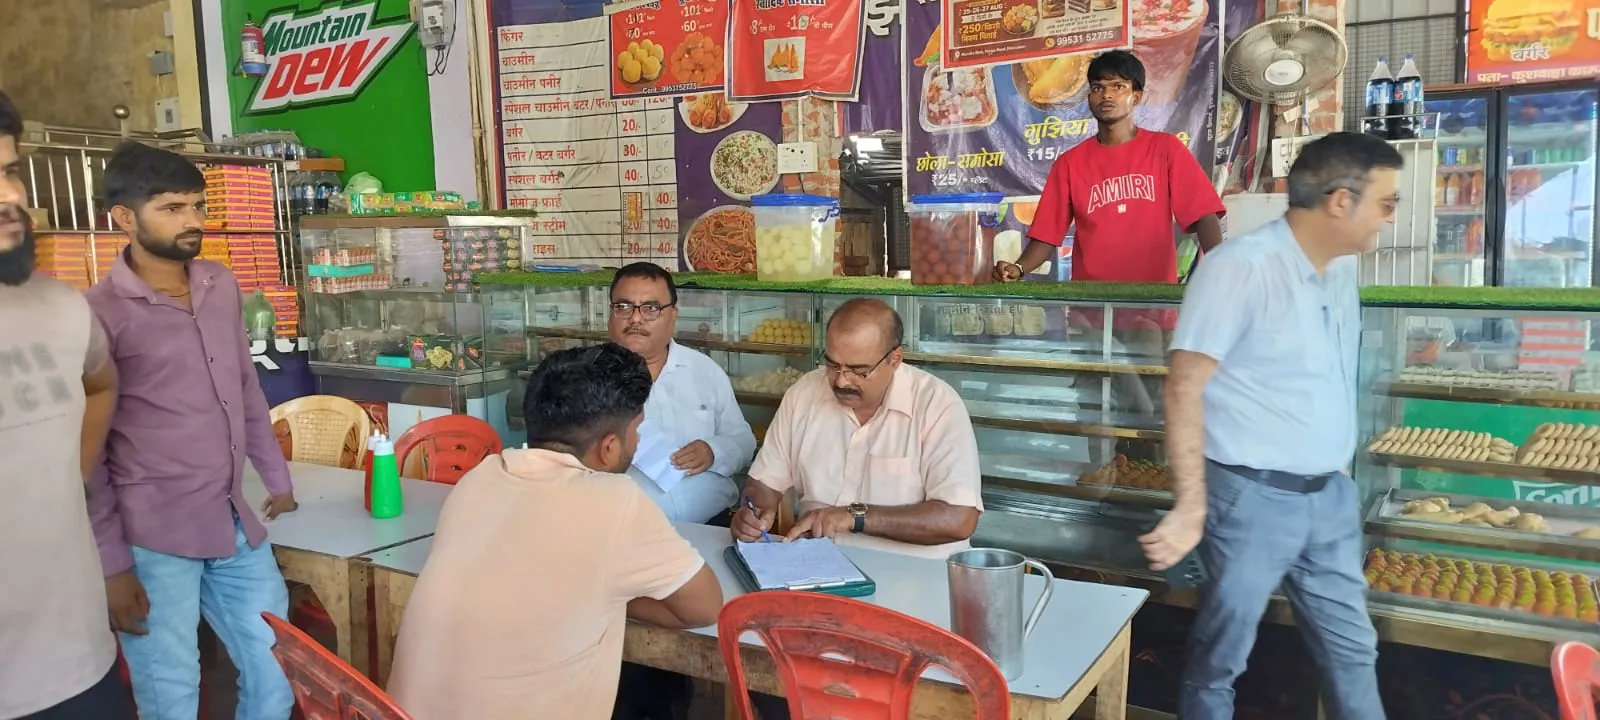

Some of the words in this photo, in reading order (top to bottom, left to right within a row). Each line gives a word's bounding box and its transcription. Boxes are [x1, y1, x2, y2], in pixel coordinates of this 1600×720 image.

[264, 13, 367, 57] Mountain
[1056, 34, 1083, 46] 99531
[1086, 30, 1114, 41] 52775
[622, 118, 641, 132] 20/-
[623, 144, 642, 156] 30/-
[624, 168, 643, 181] 40/-
[656, 192, 675, 205] 40/-
[1087, 173, 1155, 215] AMIRI
[657, 217, 676, 230] 40/-
[627, 242, 645, 255] 20/-
[658, 242, 675, 255] 40/-
